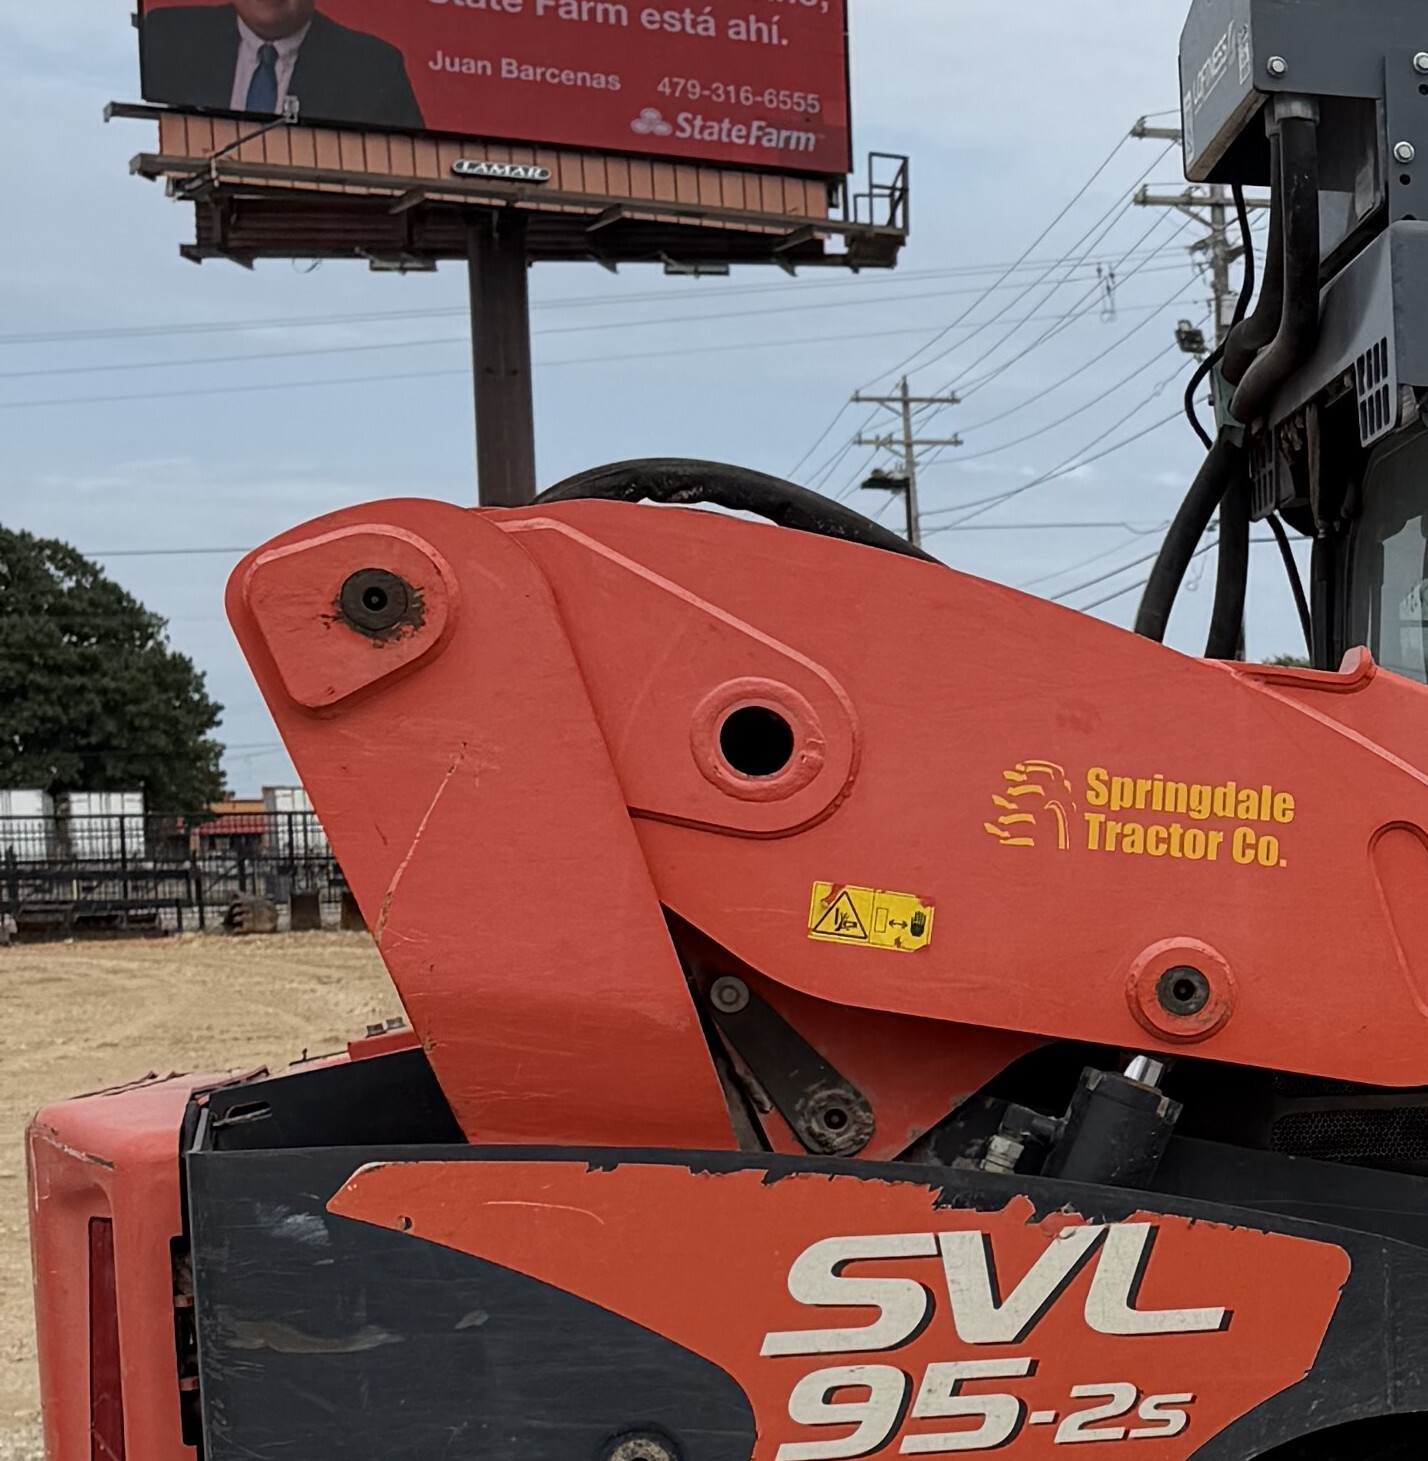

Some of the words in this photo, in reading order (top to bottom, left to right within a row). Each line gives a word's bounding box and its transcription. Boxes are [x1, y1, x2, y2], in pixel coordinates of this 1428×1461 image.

[536, 0, 628, 26] Farm
[641, 6, 715, 37] está
[728, 15, 788, 45] ahí.
[428, 51, 492, 76] Juan
[501, 57, 621, 91] Barcenas
[657, 77, 820, 114] 479-316-6555
[462, 161, 542, 180] LAMAR
[1086, 767, 1295, 822] Springdale
[1084, 812, 1223, 862] Tractor
[1231, 827, 1288, 867] Co.
[760, 1222, 1230, 1356] SVL
